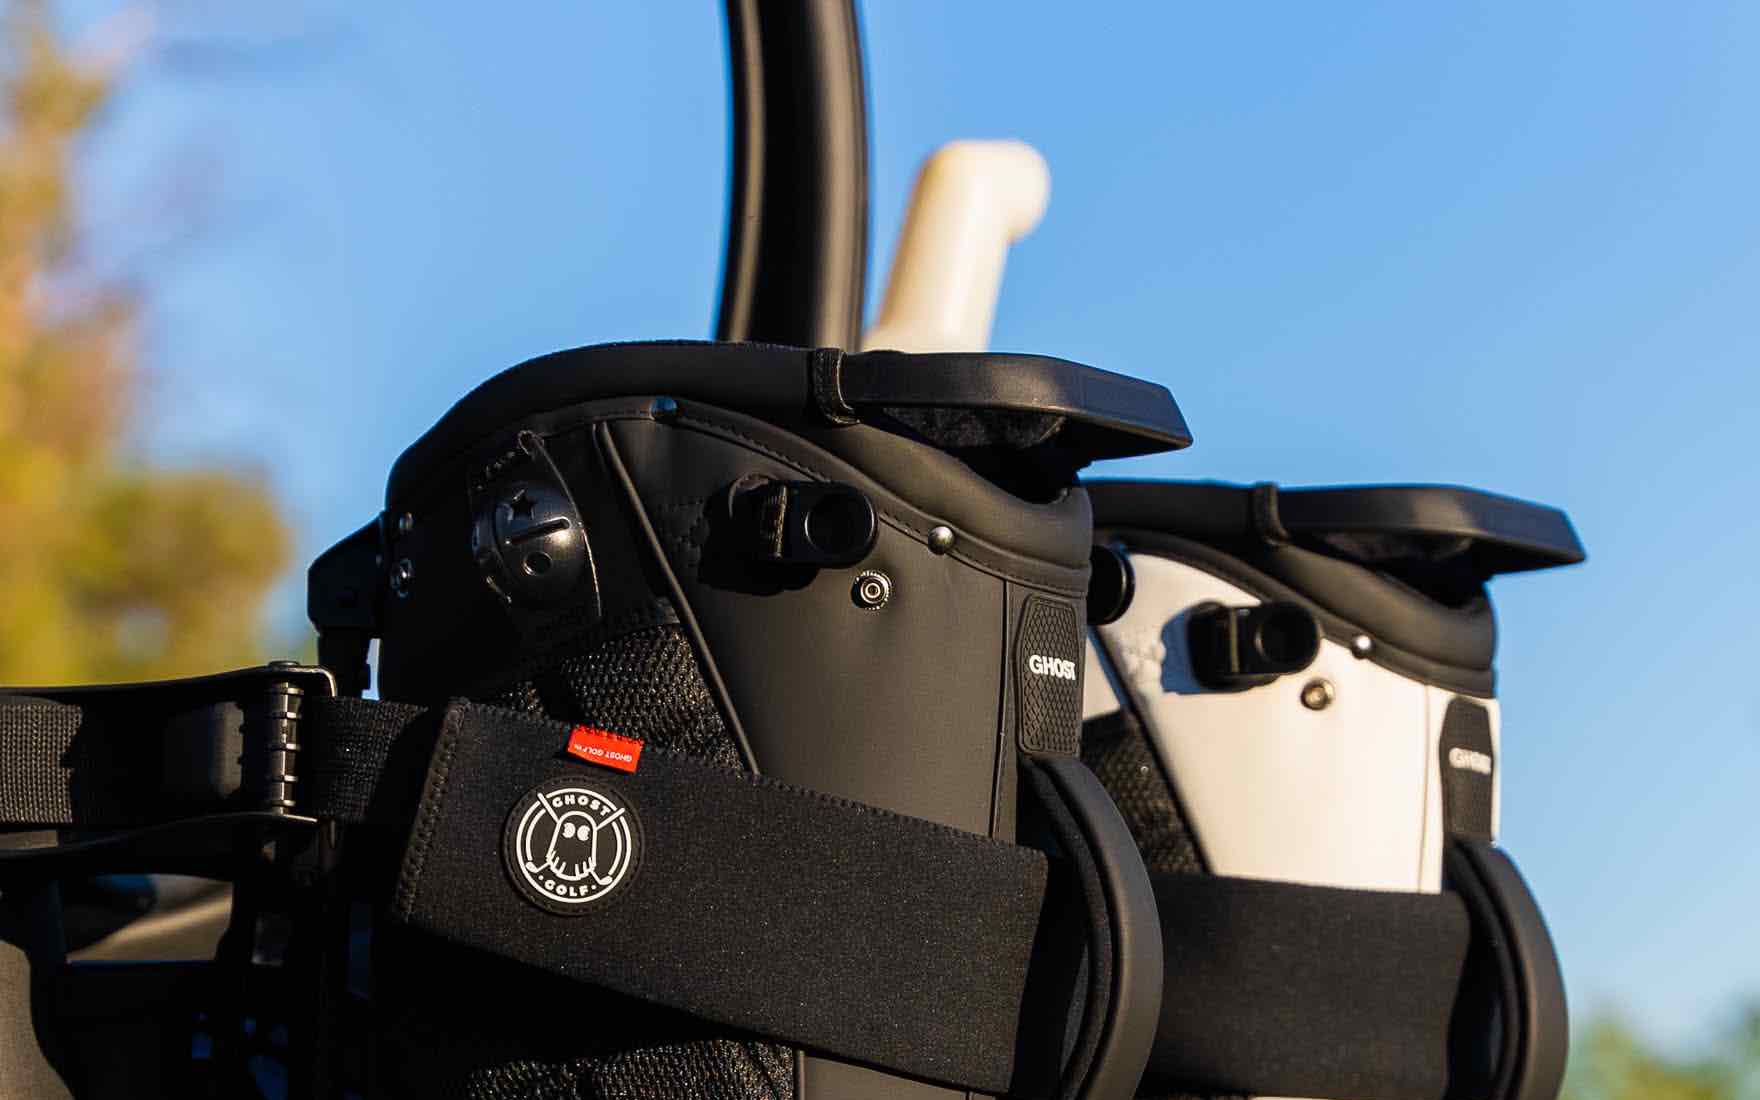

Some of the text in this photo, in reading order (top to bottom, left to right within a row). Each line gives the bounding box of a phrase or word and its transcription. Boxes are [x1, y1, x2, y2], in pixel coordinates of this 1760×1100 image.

[1029, 654, 1076, 680] GHOST
[605, 751, 633, 763] GHOST
[1449, 747, 1491, 774] GHO
[551, 795, 611, 817] GHOST
[544, 879, 589, 897] GOLF
